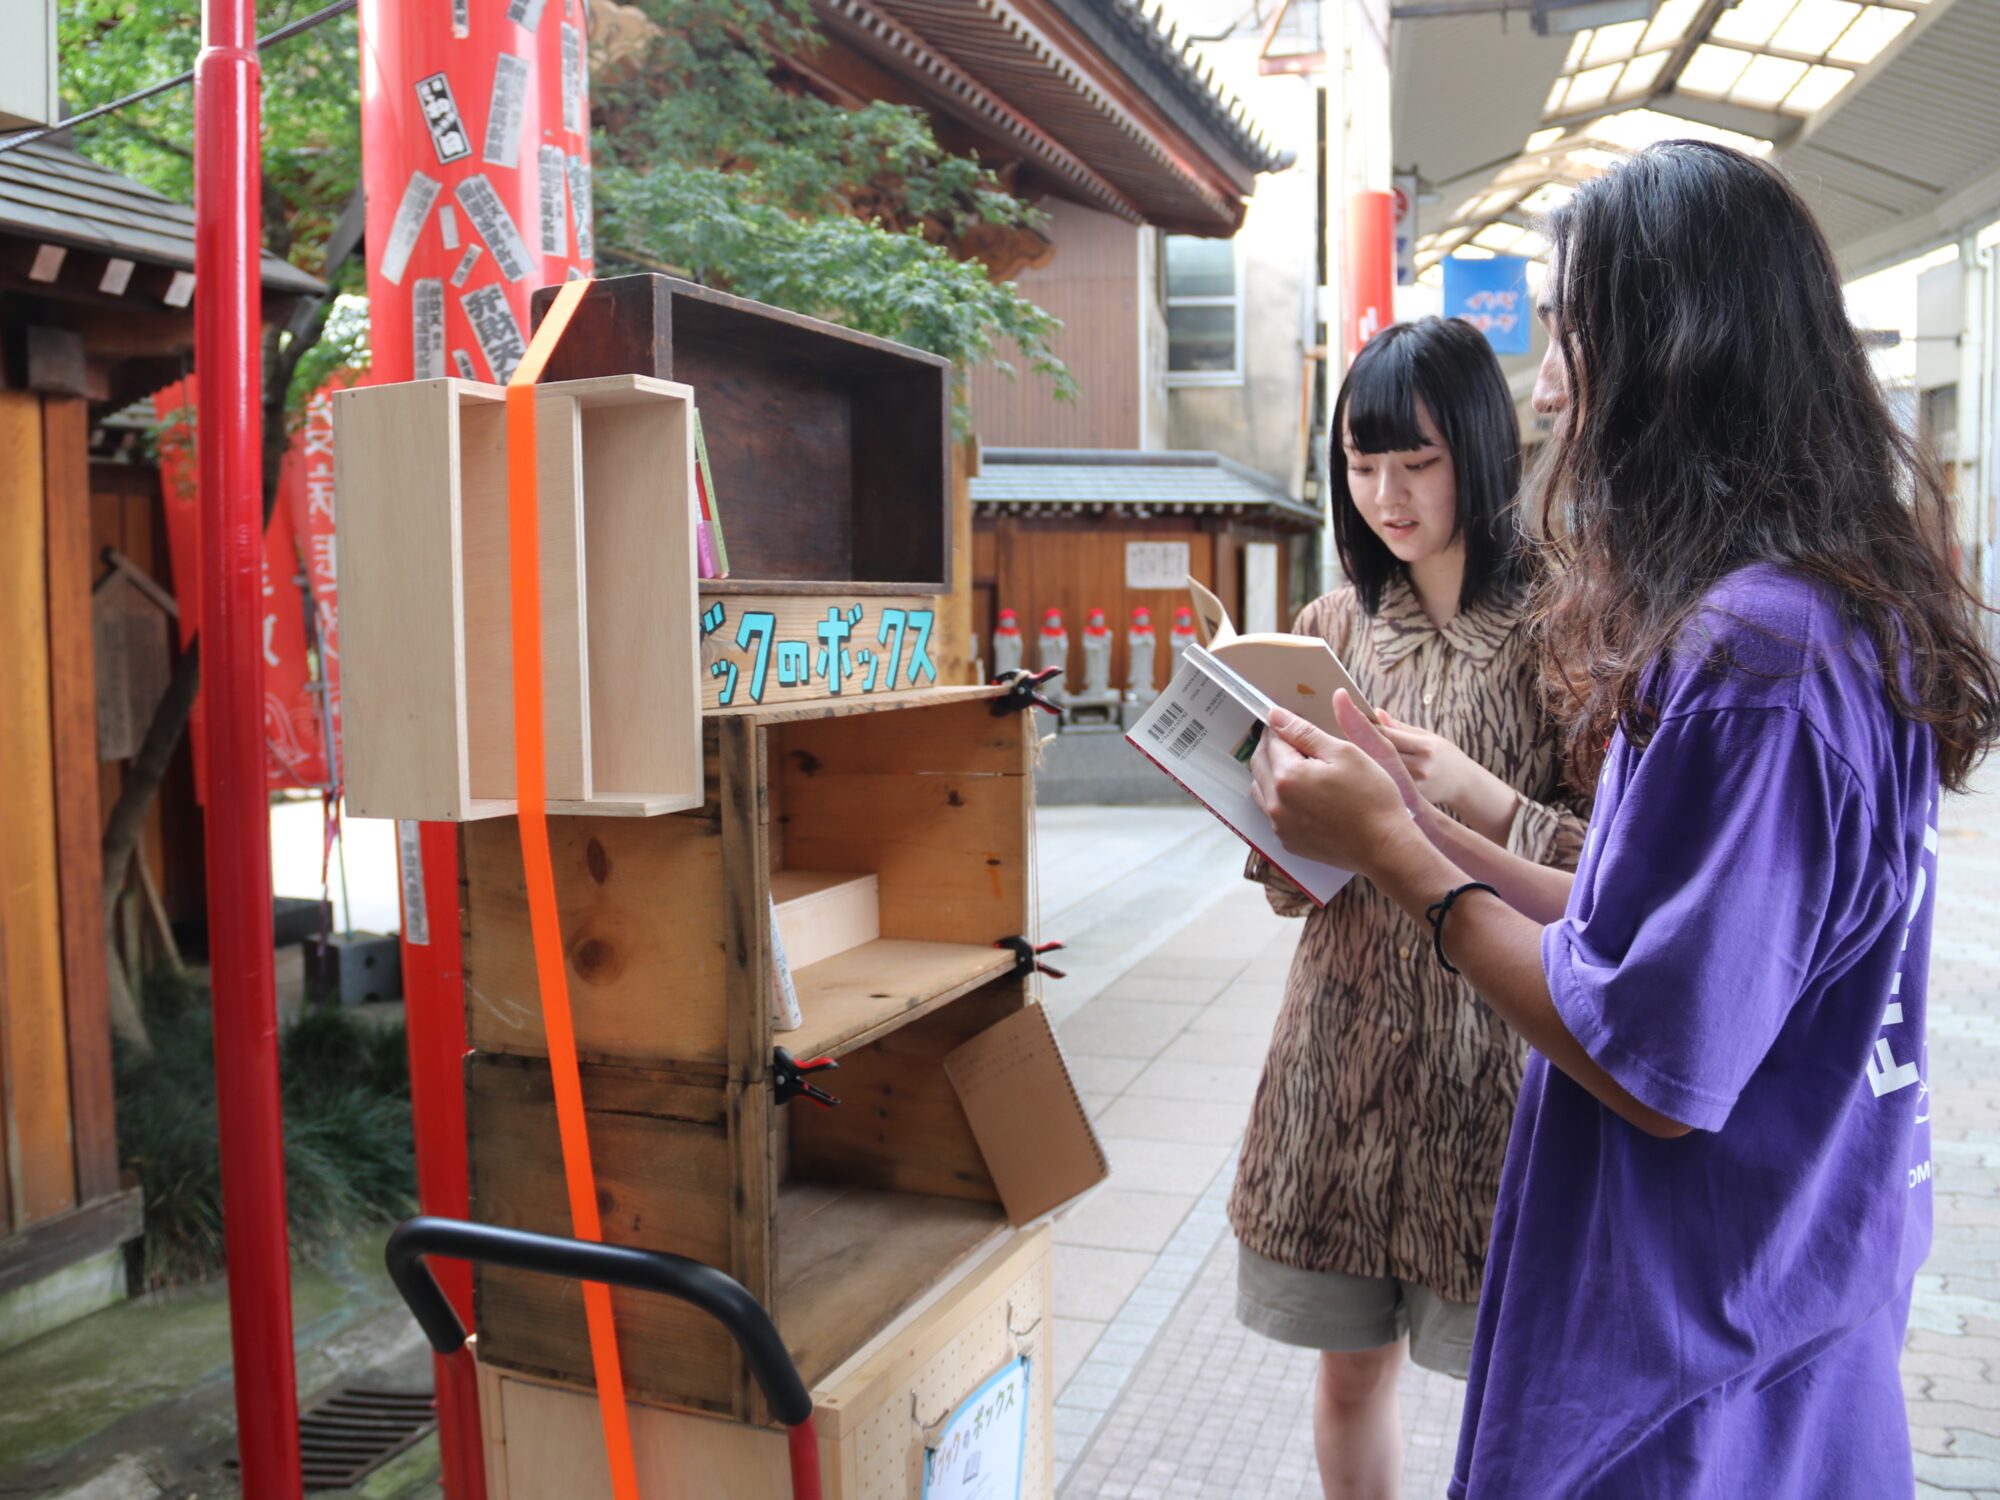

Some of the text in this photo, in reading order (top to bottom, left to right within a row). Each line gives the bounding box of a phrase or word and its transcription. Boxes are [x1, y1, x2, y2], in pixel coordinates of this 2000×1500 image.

[701, 601, 937, 706] ックのボックス
